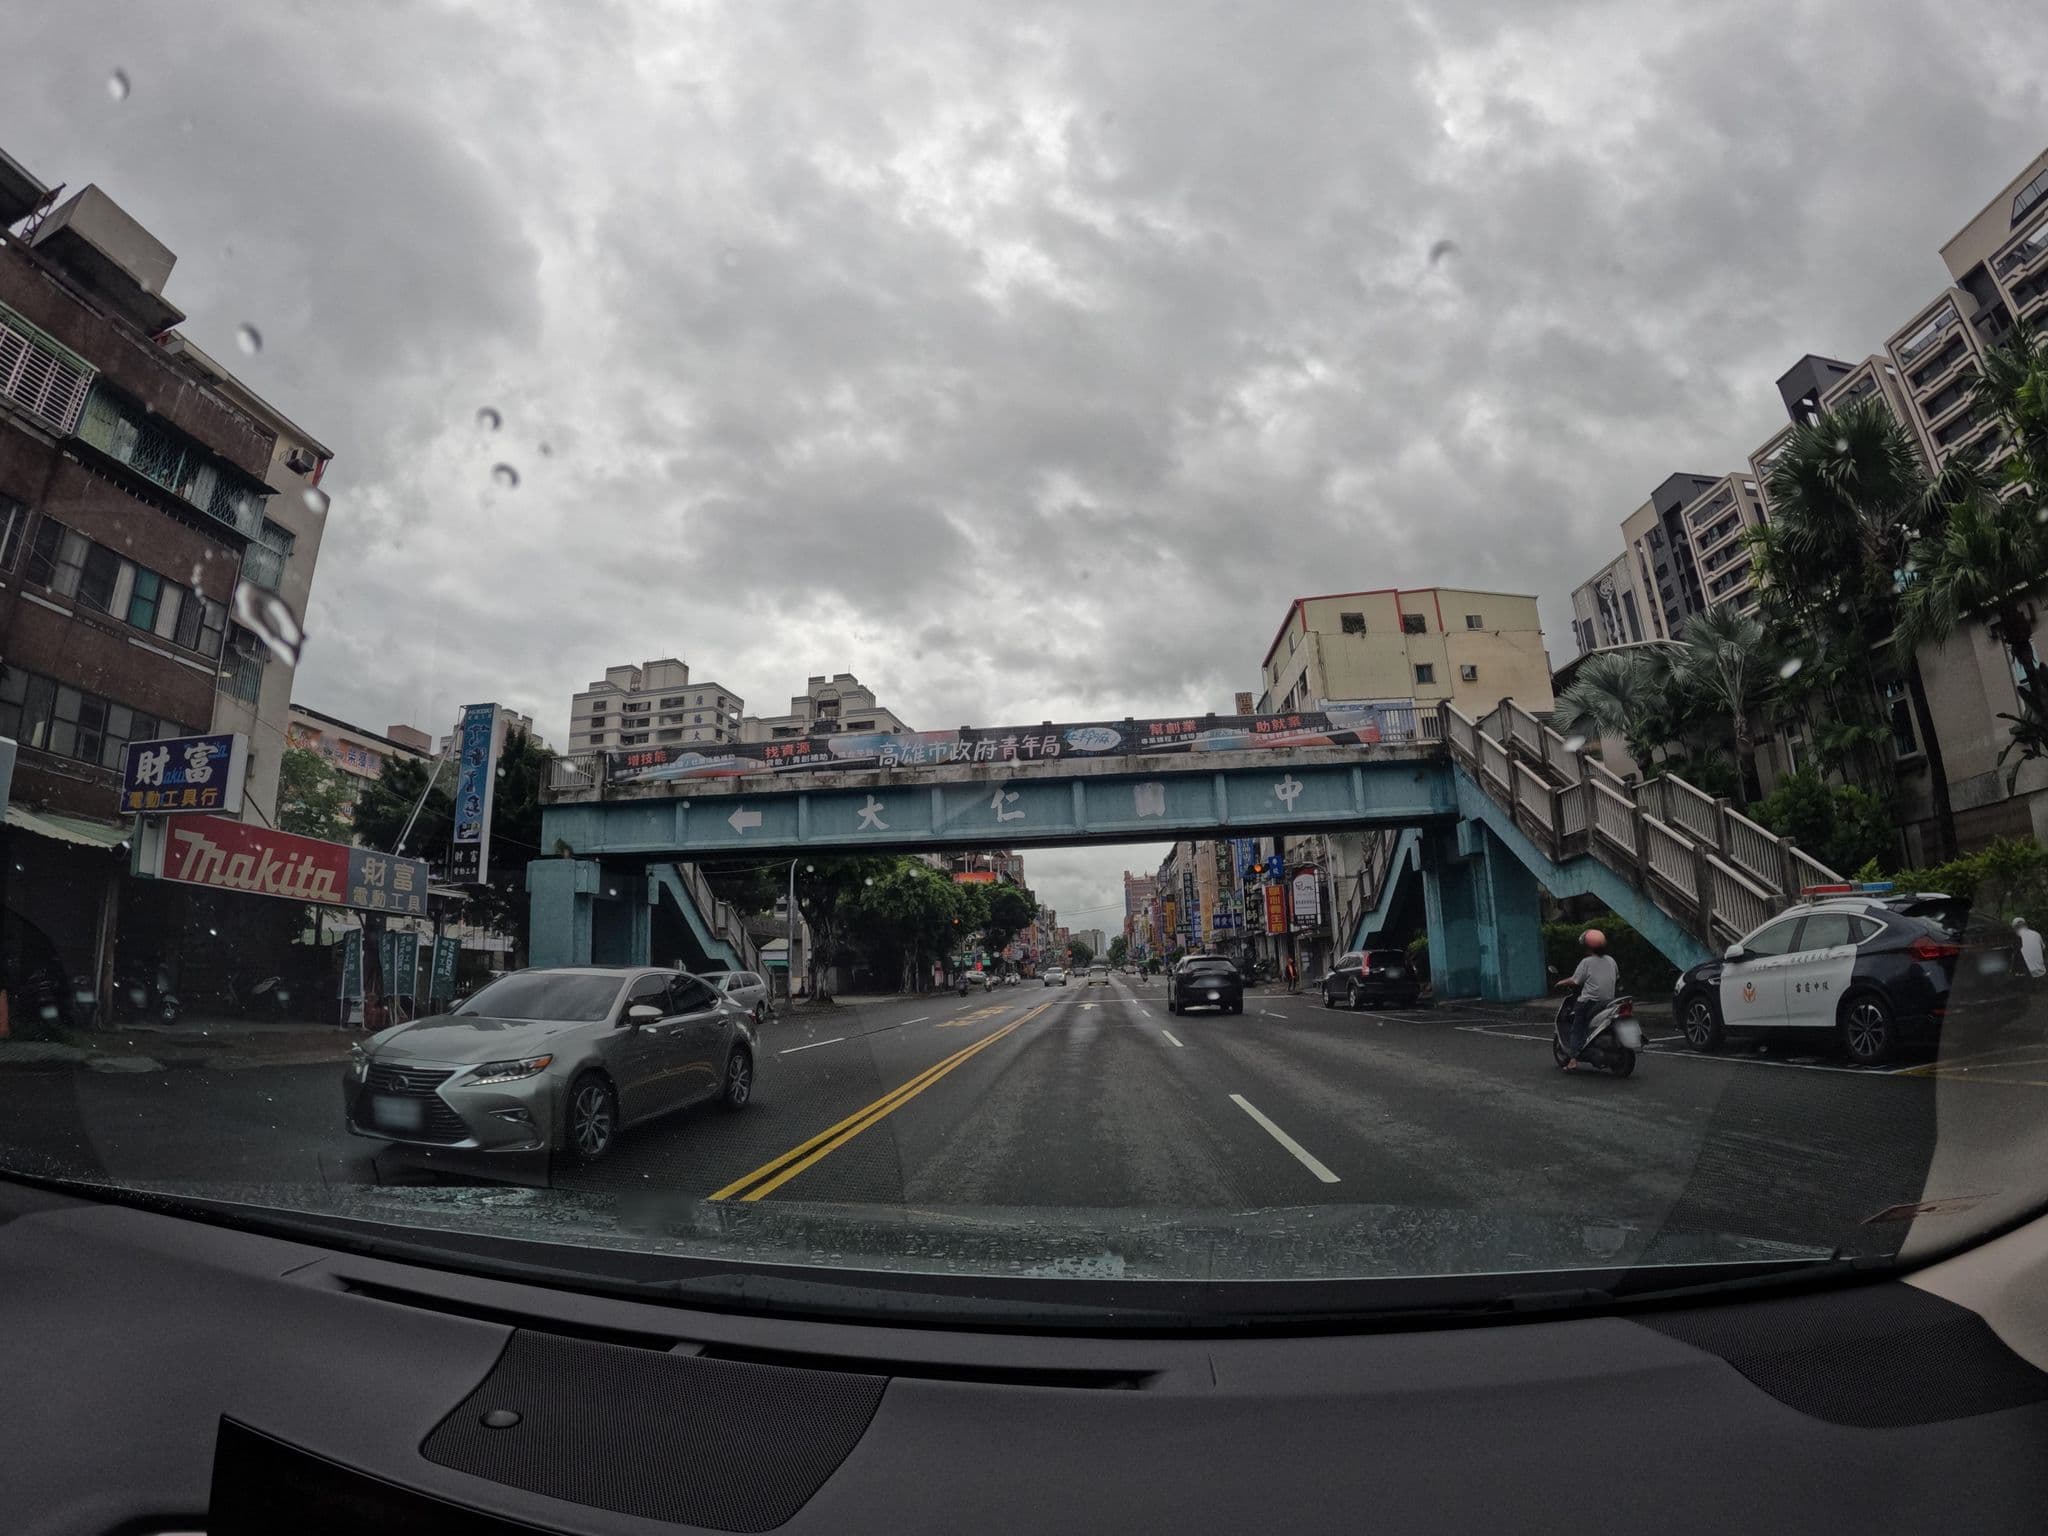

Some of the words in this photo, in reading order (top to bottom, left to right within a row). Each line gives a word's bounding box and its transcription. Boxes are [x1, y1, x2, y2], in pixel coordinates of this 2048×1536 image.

[1255, 715, 1302, 733] 助就業
[626, 750, 668, 767] 增技能
[765, 741, 811, 758] 找資源
[879, 734, 1062, 768] 高雄市政府青年局
[135, 742, 219, 786] 財富
[128, 787, 218, 809] 電動工具行
[857, 773, 1303, 832] 大仁中
[361, 856, 415, 891] 財富
[353, 886, 421, 913] 電動工具
